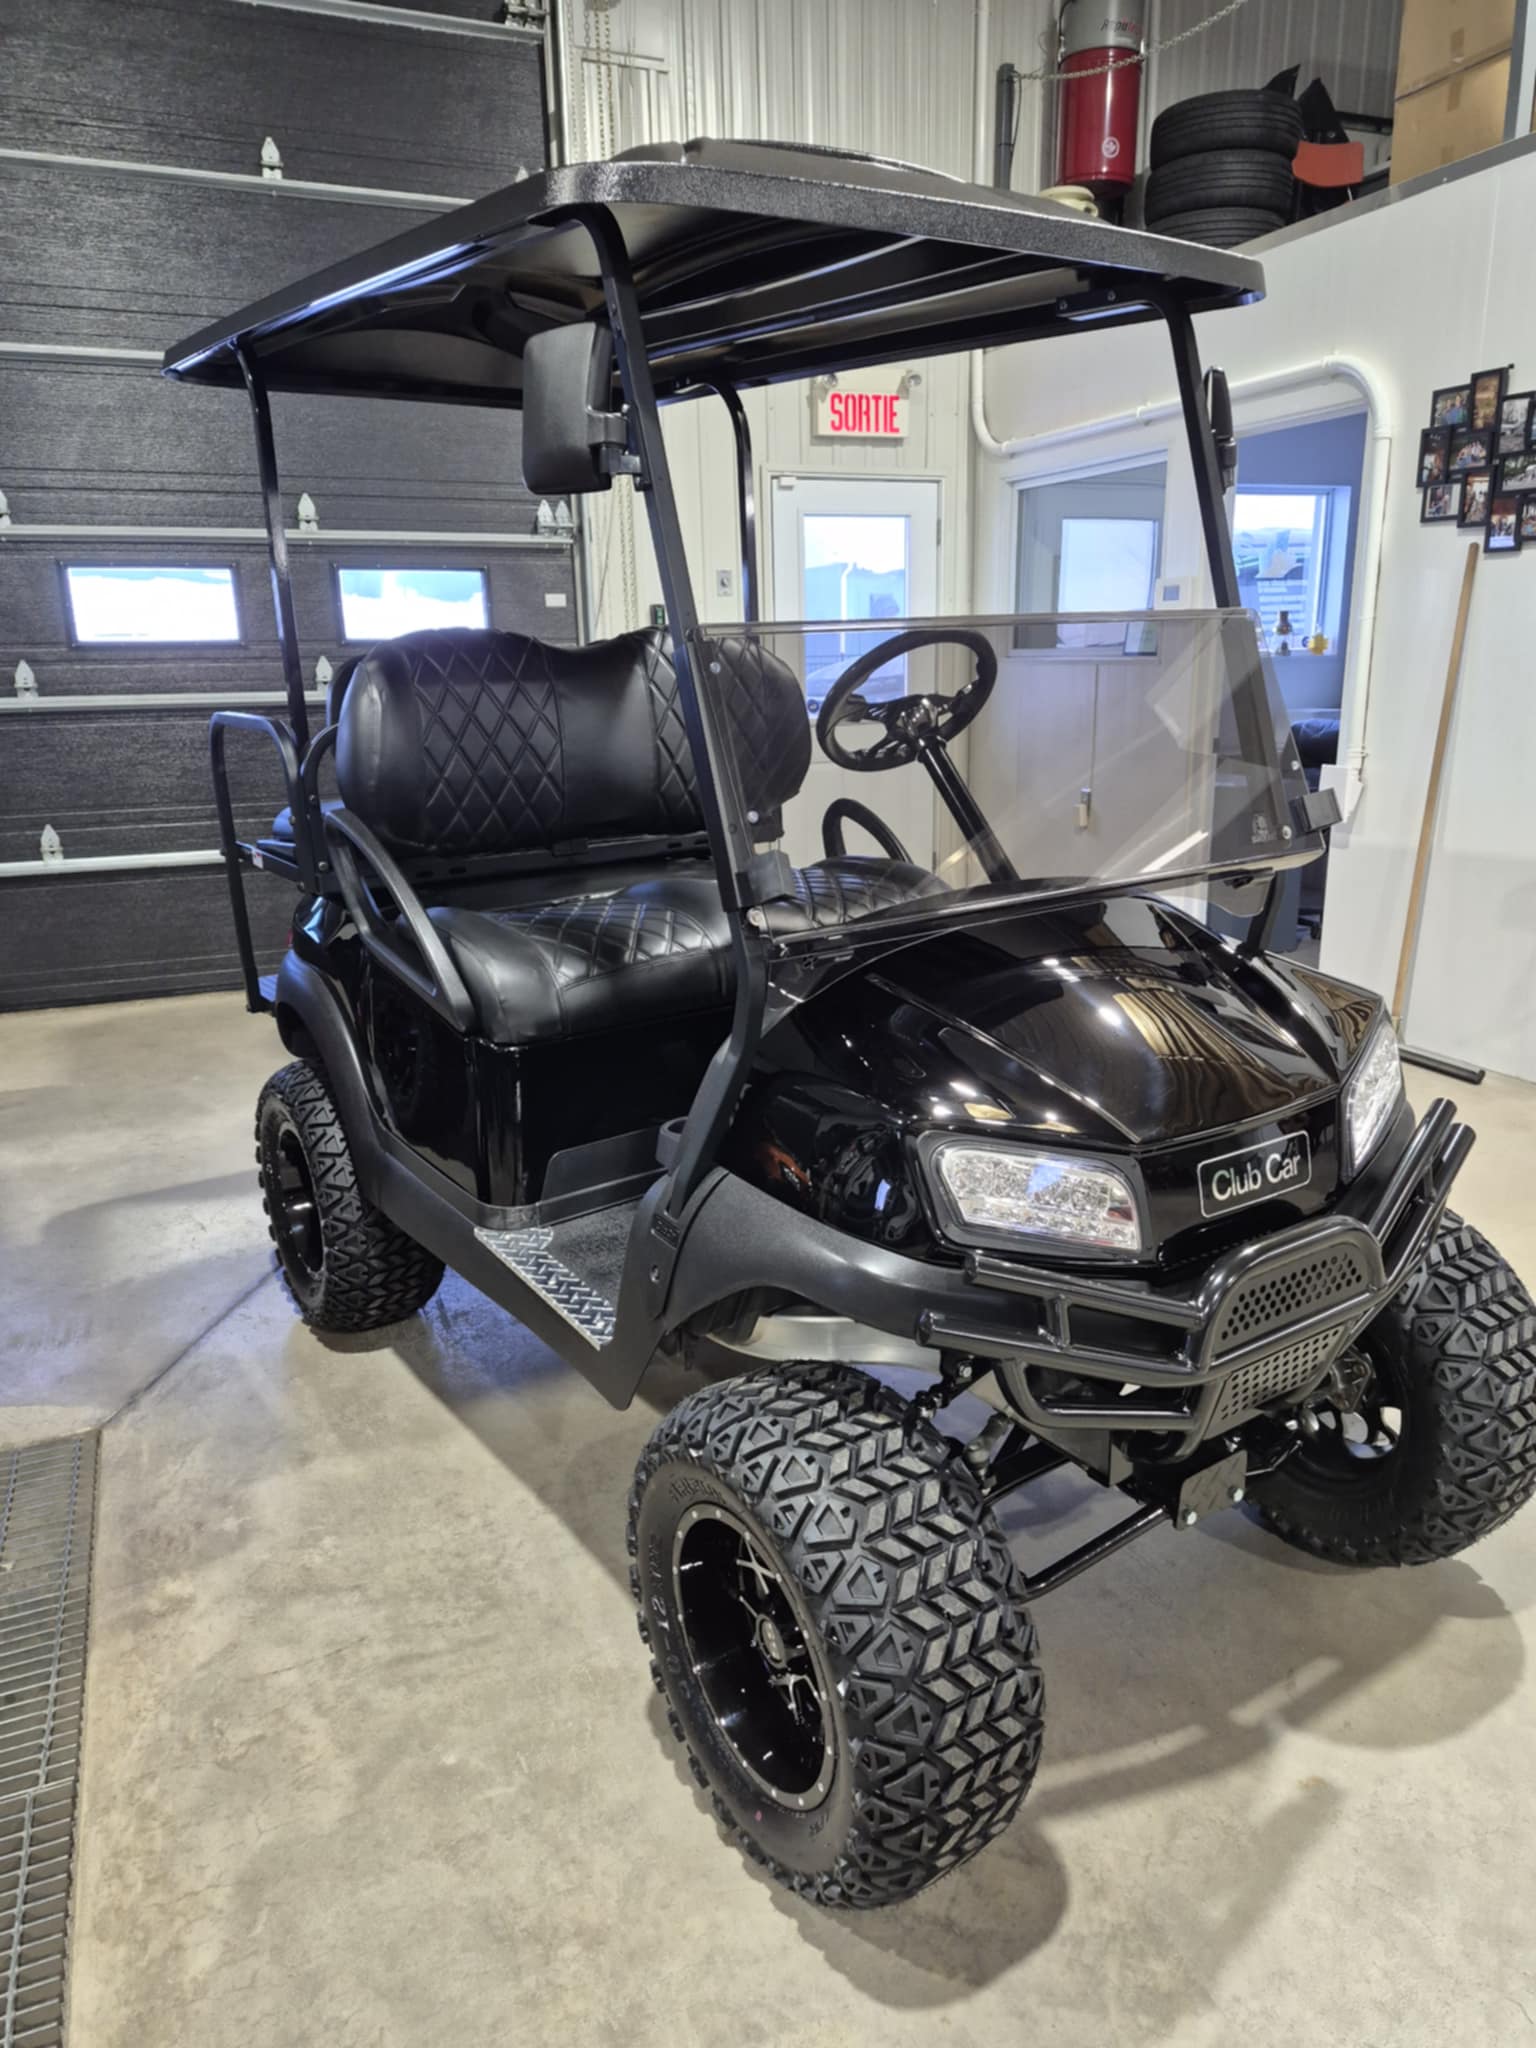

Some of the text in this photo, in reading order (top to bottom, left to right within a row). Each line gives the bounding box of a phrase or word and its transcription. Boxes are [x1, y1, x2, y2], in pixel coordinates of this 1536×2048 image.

[830, 393, 900, 433] SORTIE
[1212, 1153, 1301, 1200] Club Car
